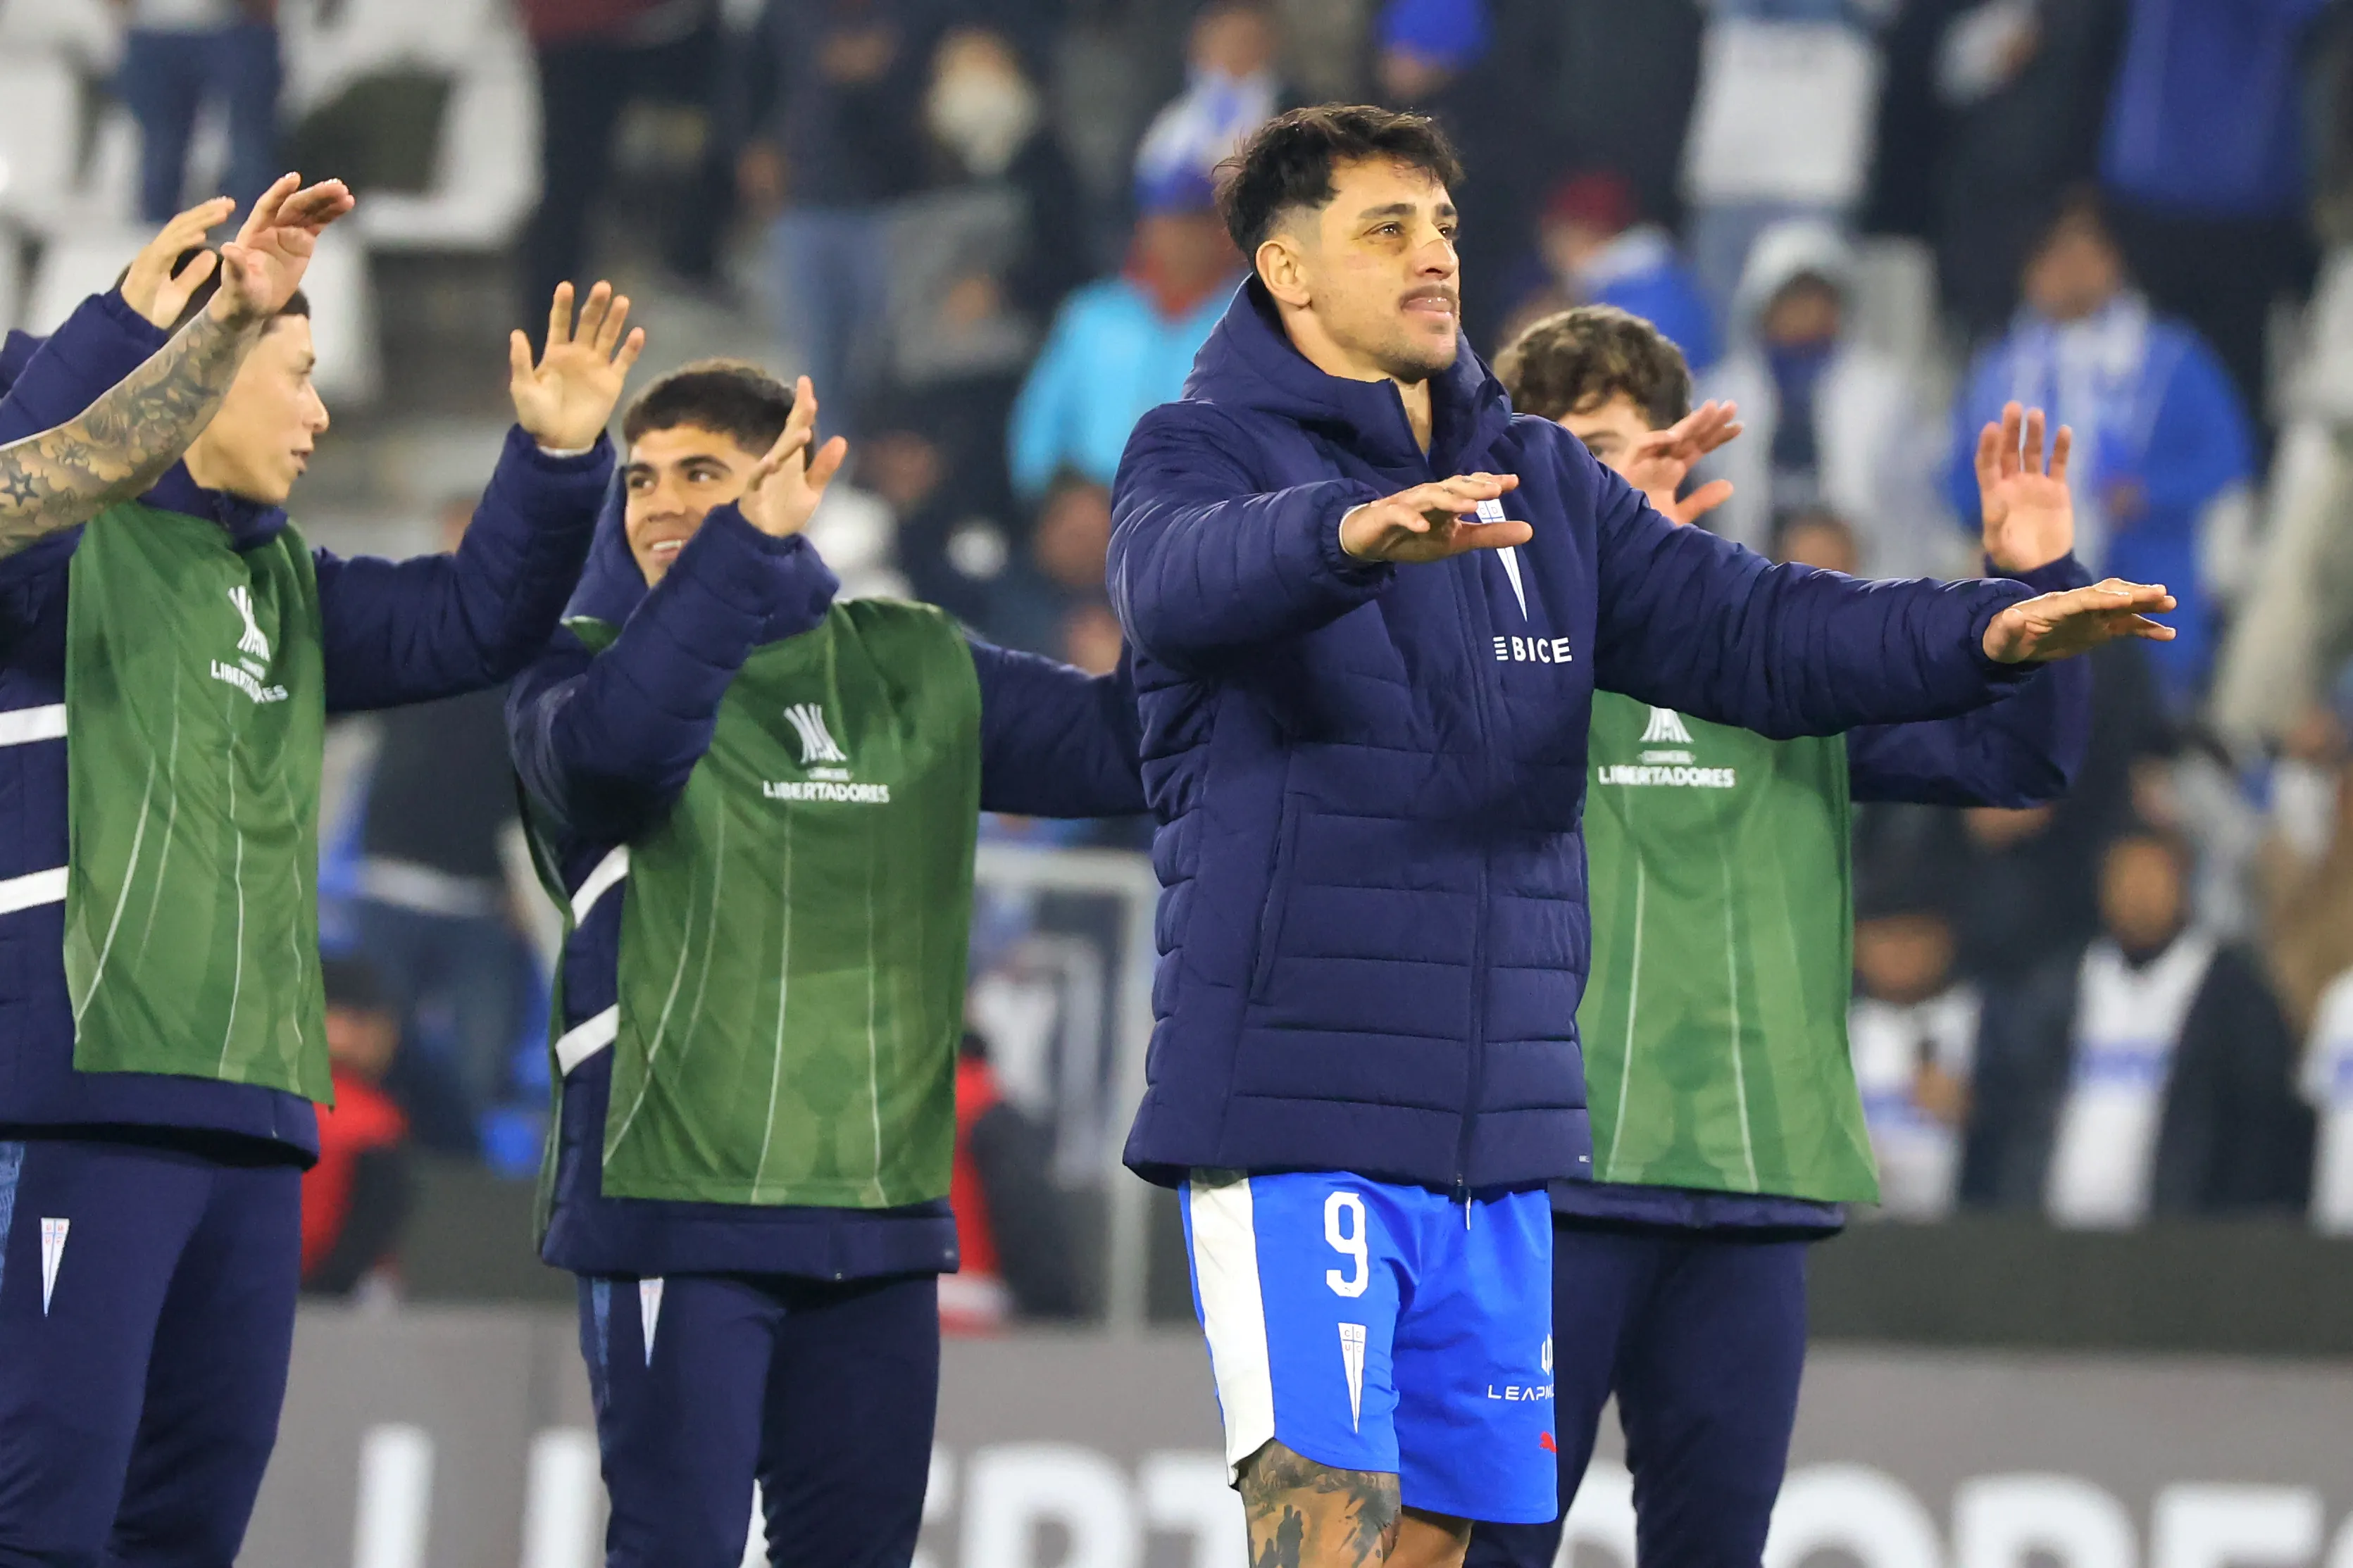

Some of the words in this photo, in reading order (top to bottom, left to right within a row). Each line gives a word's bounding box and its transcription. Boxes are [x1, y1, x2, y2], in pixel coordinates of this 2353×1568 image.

[1511, 636, 1573, 663] BICE
[1597, 765, 1735, 789] LIBERTADORES
[763, 780, 890, 803] LIBERTADORES
[1324, 1191, 1369, 1298] 9
[1487, 1384, 1554, 1401] LEAPM
